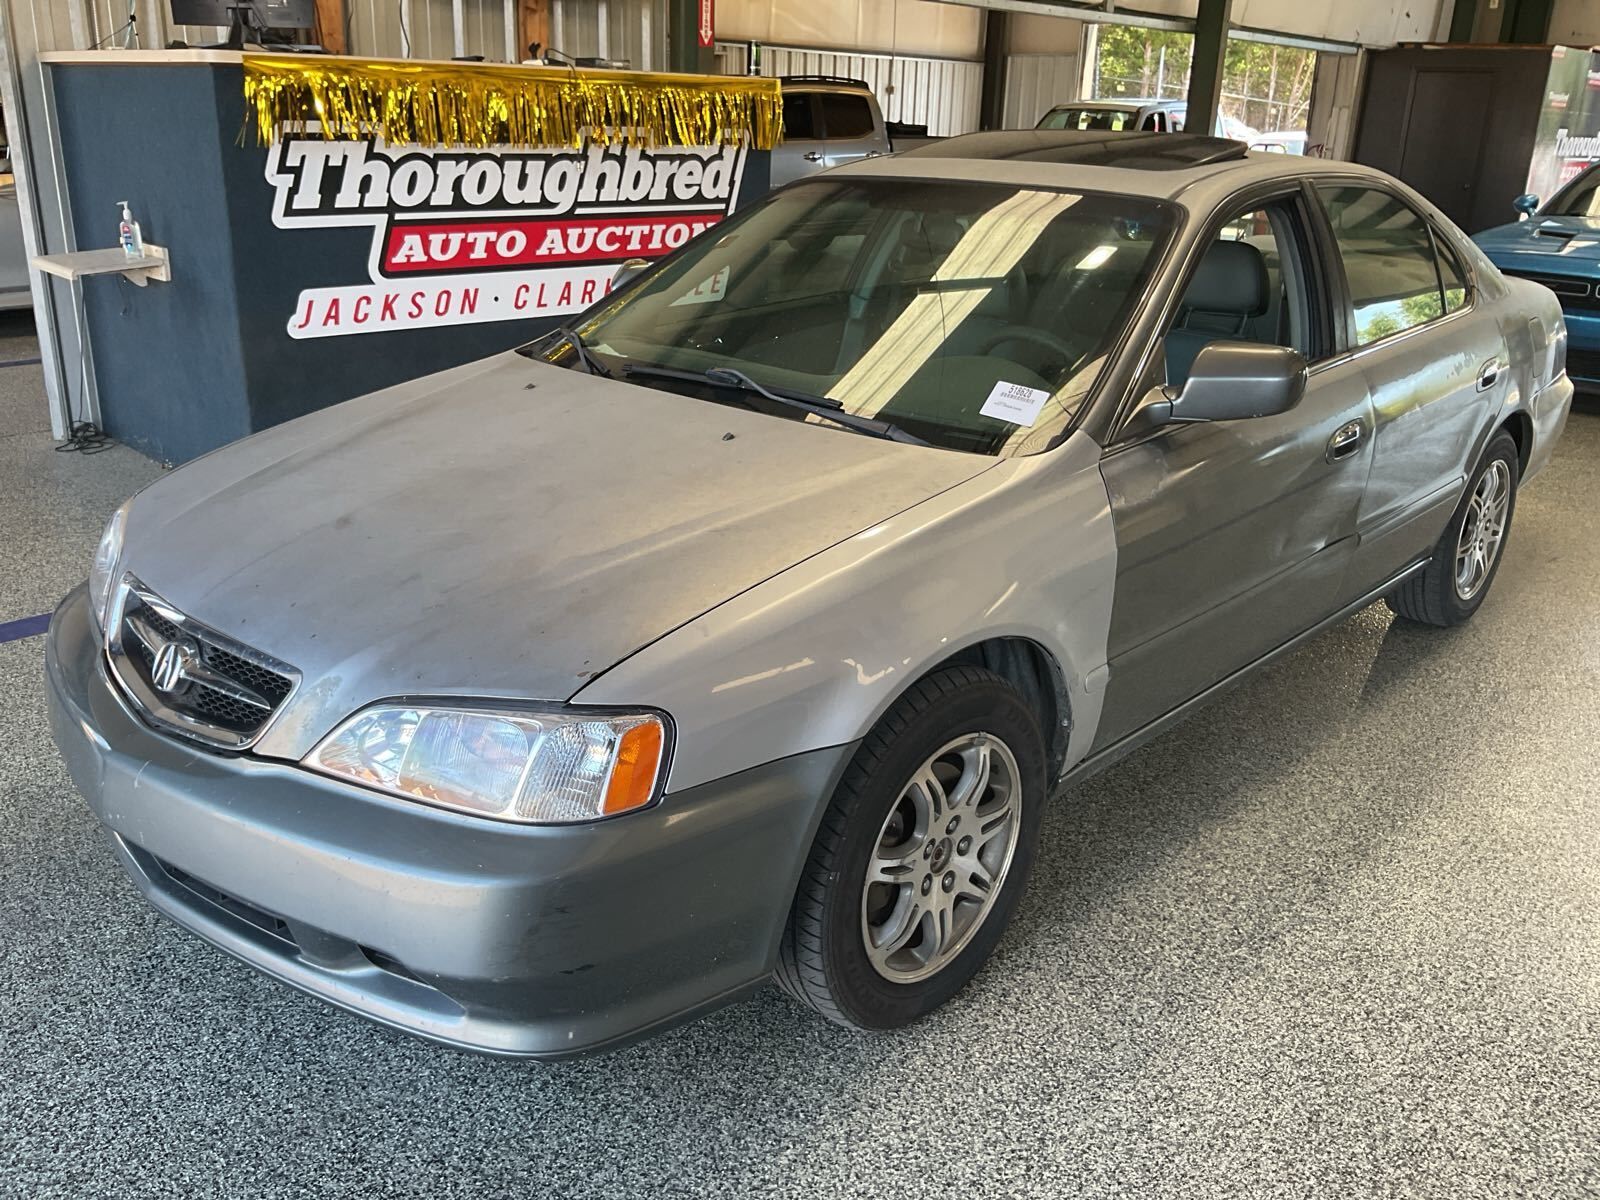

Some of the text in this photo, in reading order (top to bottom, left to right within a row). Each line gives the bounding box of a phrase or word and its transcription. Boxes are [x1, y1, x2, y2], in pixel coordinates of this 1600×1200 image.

[286, 140, 735, 215] Thoroughbred
[391, 231, 527, 263] AUTO
[298, 287, 480, 328] JACKSON
